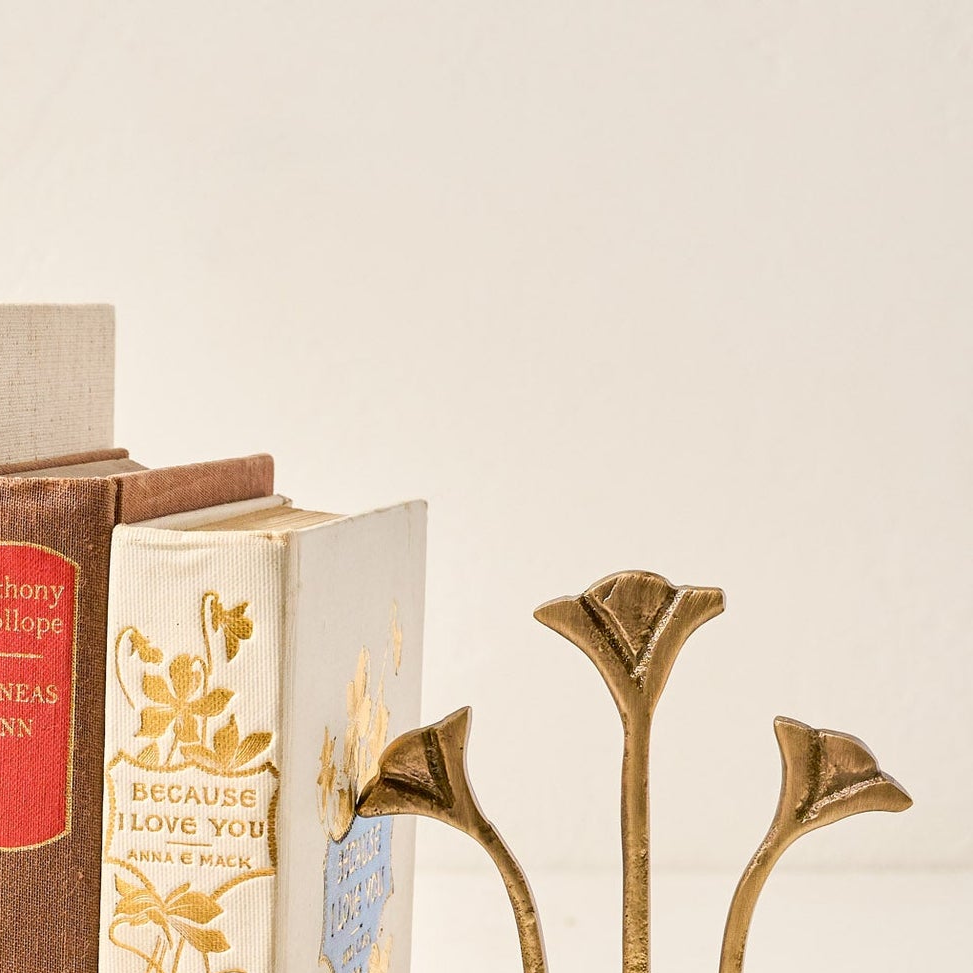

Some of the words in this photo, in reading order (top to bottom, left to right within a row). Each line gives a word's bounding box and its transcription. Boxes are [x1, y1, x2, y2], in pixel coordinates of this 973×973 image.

[131, 782, 258, 809] BECAUSE
[118, 812, 125, 832] I
[130, 813, 198, 836] LOVE
[208, 817, 266, 839] YOU
[127, 848, 175, 865] ANNA
[180, 852, 194, 866] E
[199, 854, 253, 870] MACK
[337, 821, 383, 885] BECAUSE
[337, 881, 363, 932] LOVE
[364, 865, 386, 909] YOU
